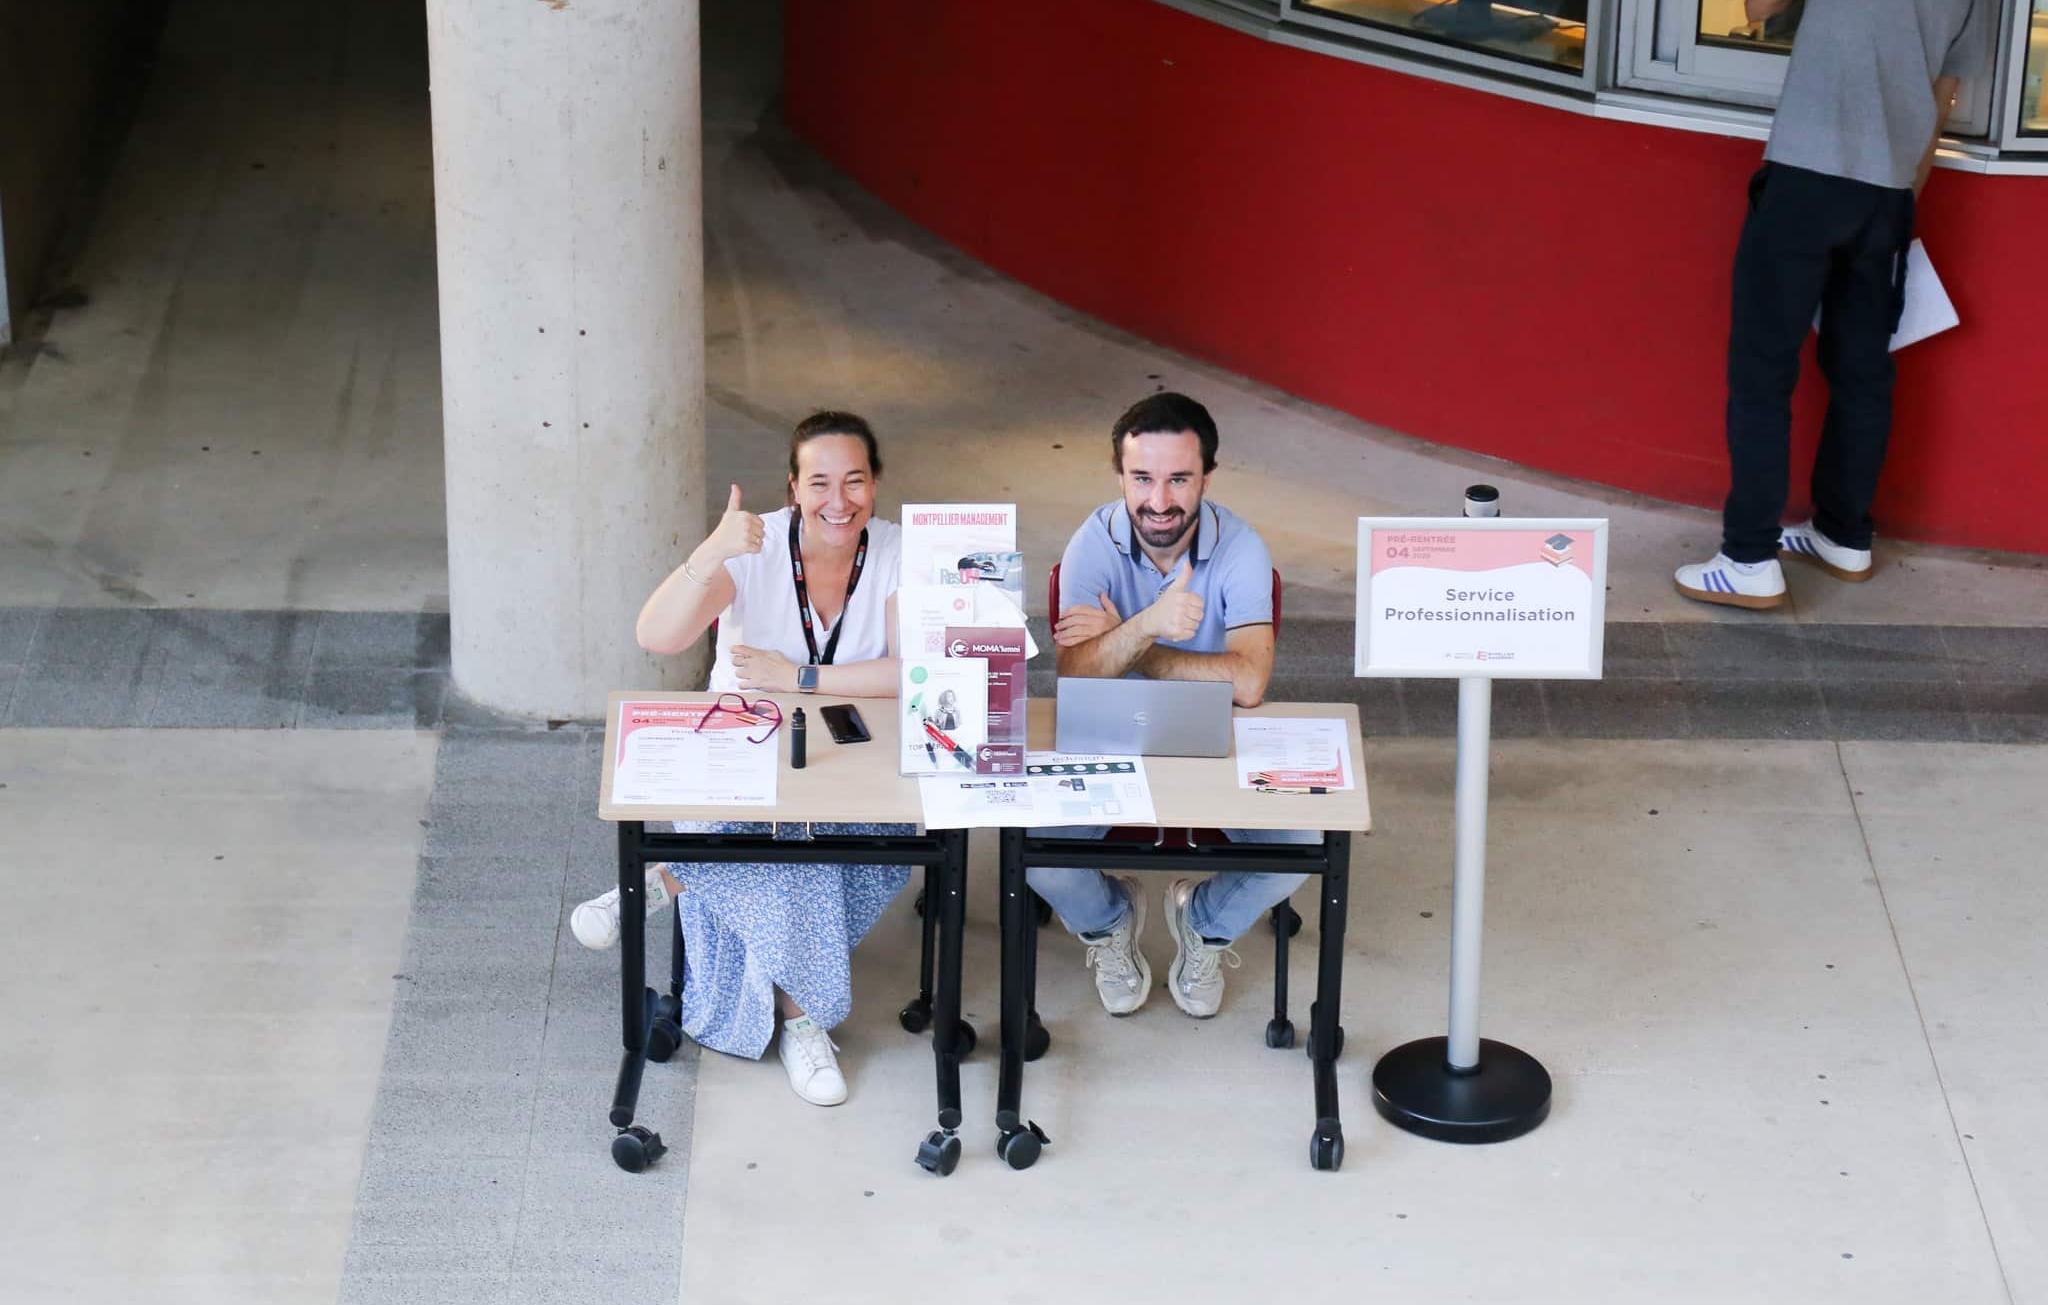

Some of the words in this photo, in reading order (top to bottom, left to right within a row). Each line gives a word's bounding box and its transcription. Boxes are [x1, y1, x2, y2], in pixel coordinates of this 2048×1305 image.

[912, 513, 959, 525] MONTPELLIER
[960, 513, 1008, 525] MANAGEMENT
[1386, 547, 1410, 558] 04
[1446, 589, 1515, 601] Service
[1384, 607, 1575, 621] Professionnalisation
